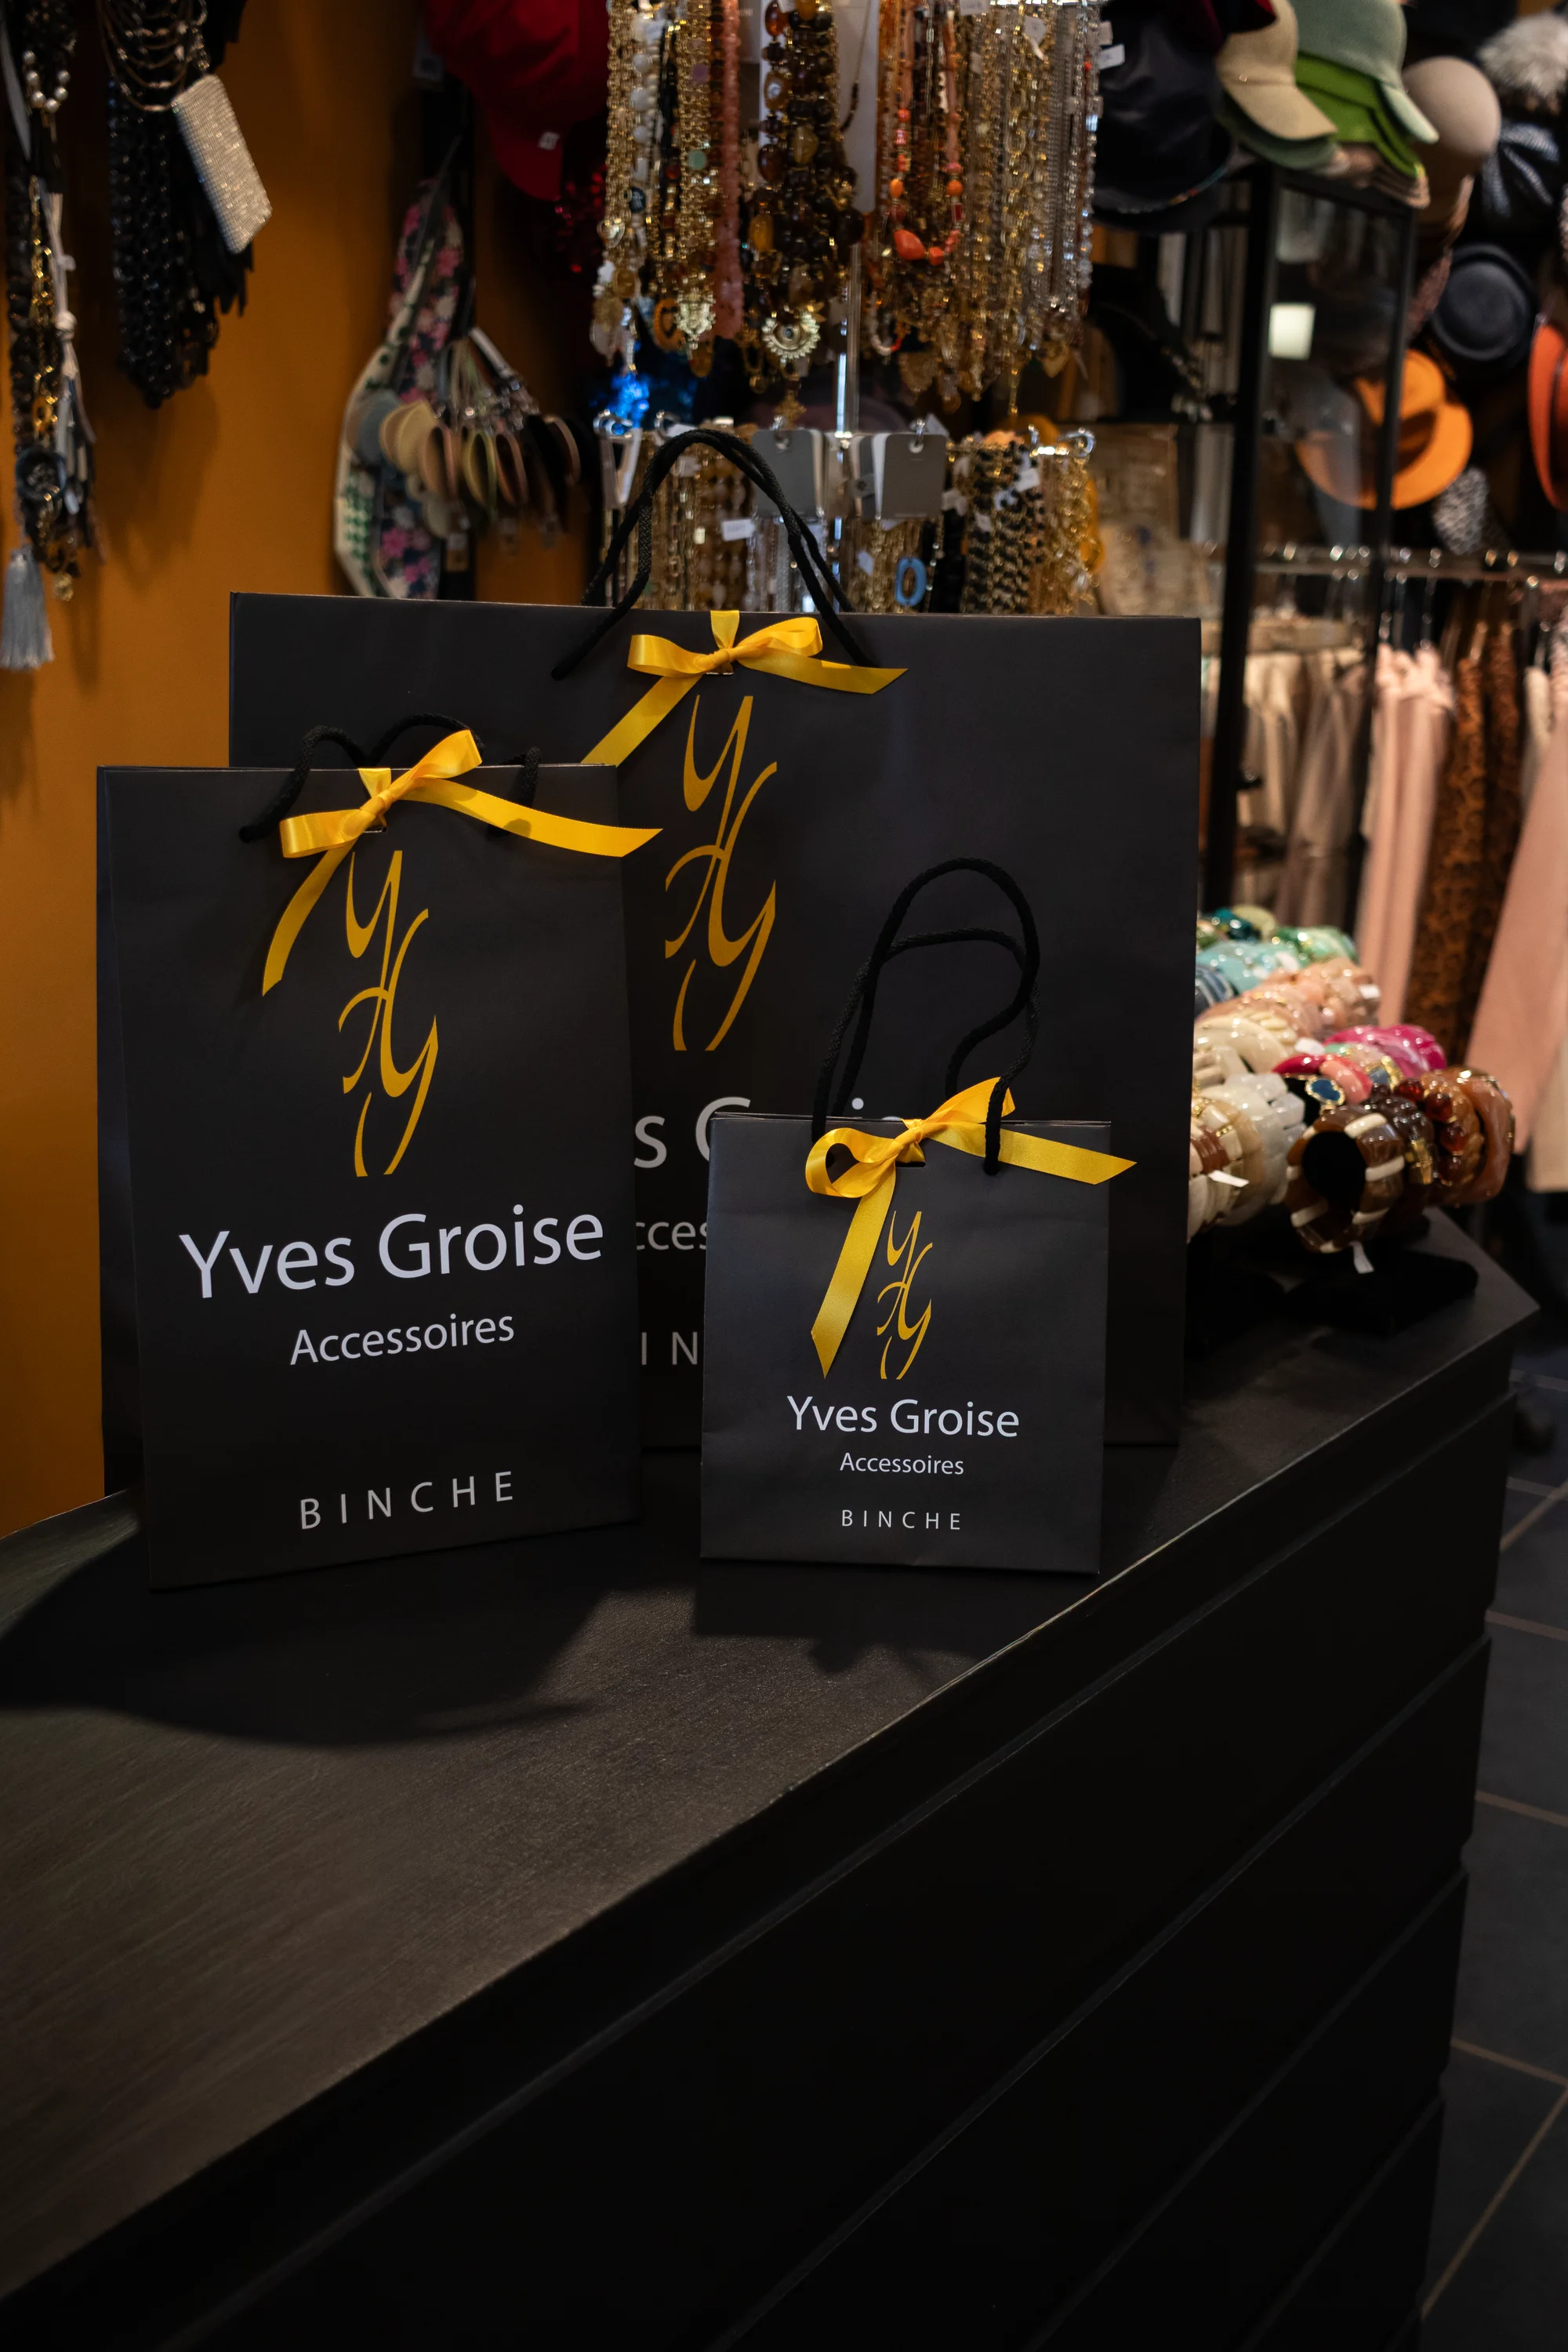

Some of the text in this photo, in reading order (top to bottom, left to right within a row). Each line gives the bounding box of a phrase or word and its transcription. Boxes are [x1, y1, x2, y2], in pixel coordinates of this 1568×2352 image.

[178, 1230, 355, 1299] Yves
[379, 1203, 604, 1279] Groise
[290, 1312, 514, 1366] Accessoires
[786, 1396, 1019, 1438] Yves Groise
[839, 1452, 964, 1475] Accessoires
[300, 1471, 514, 1530] BINCHE
[841, 1509, 960, 1530] BINCHE
